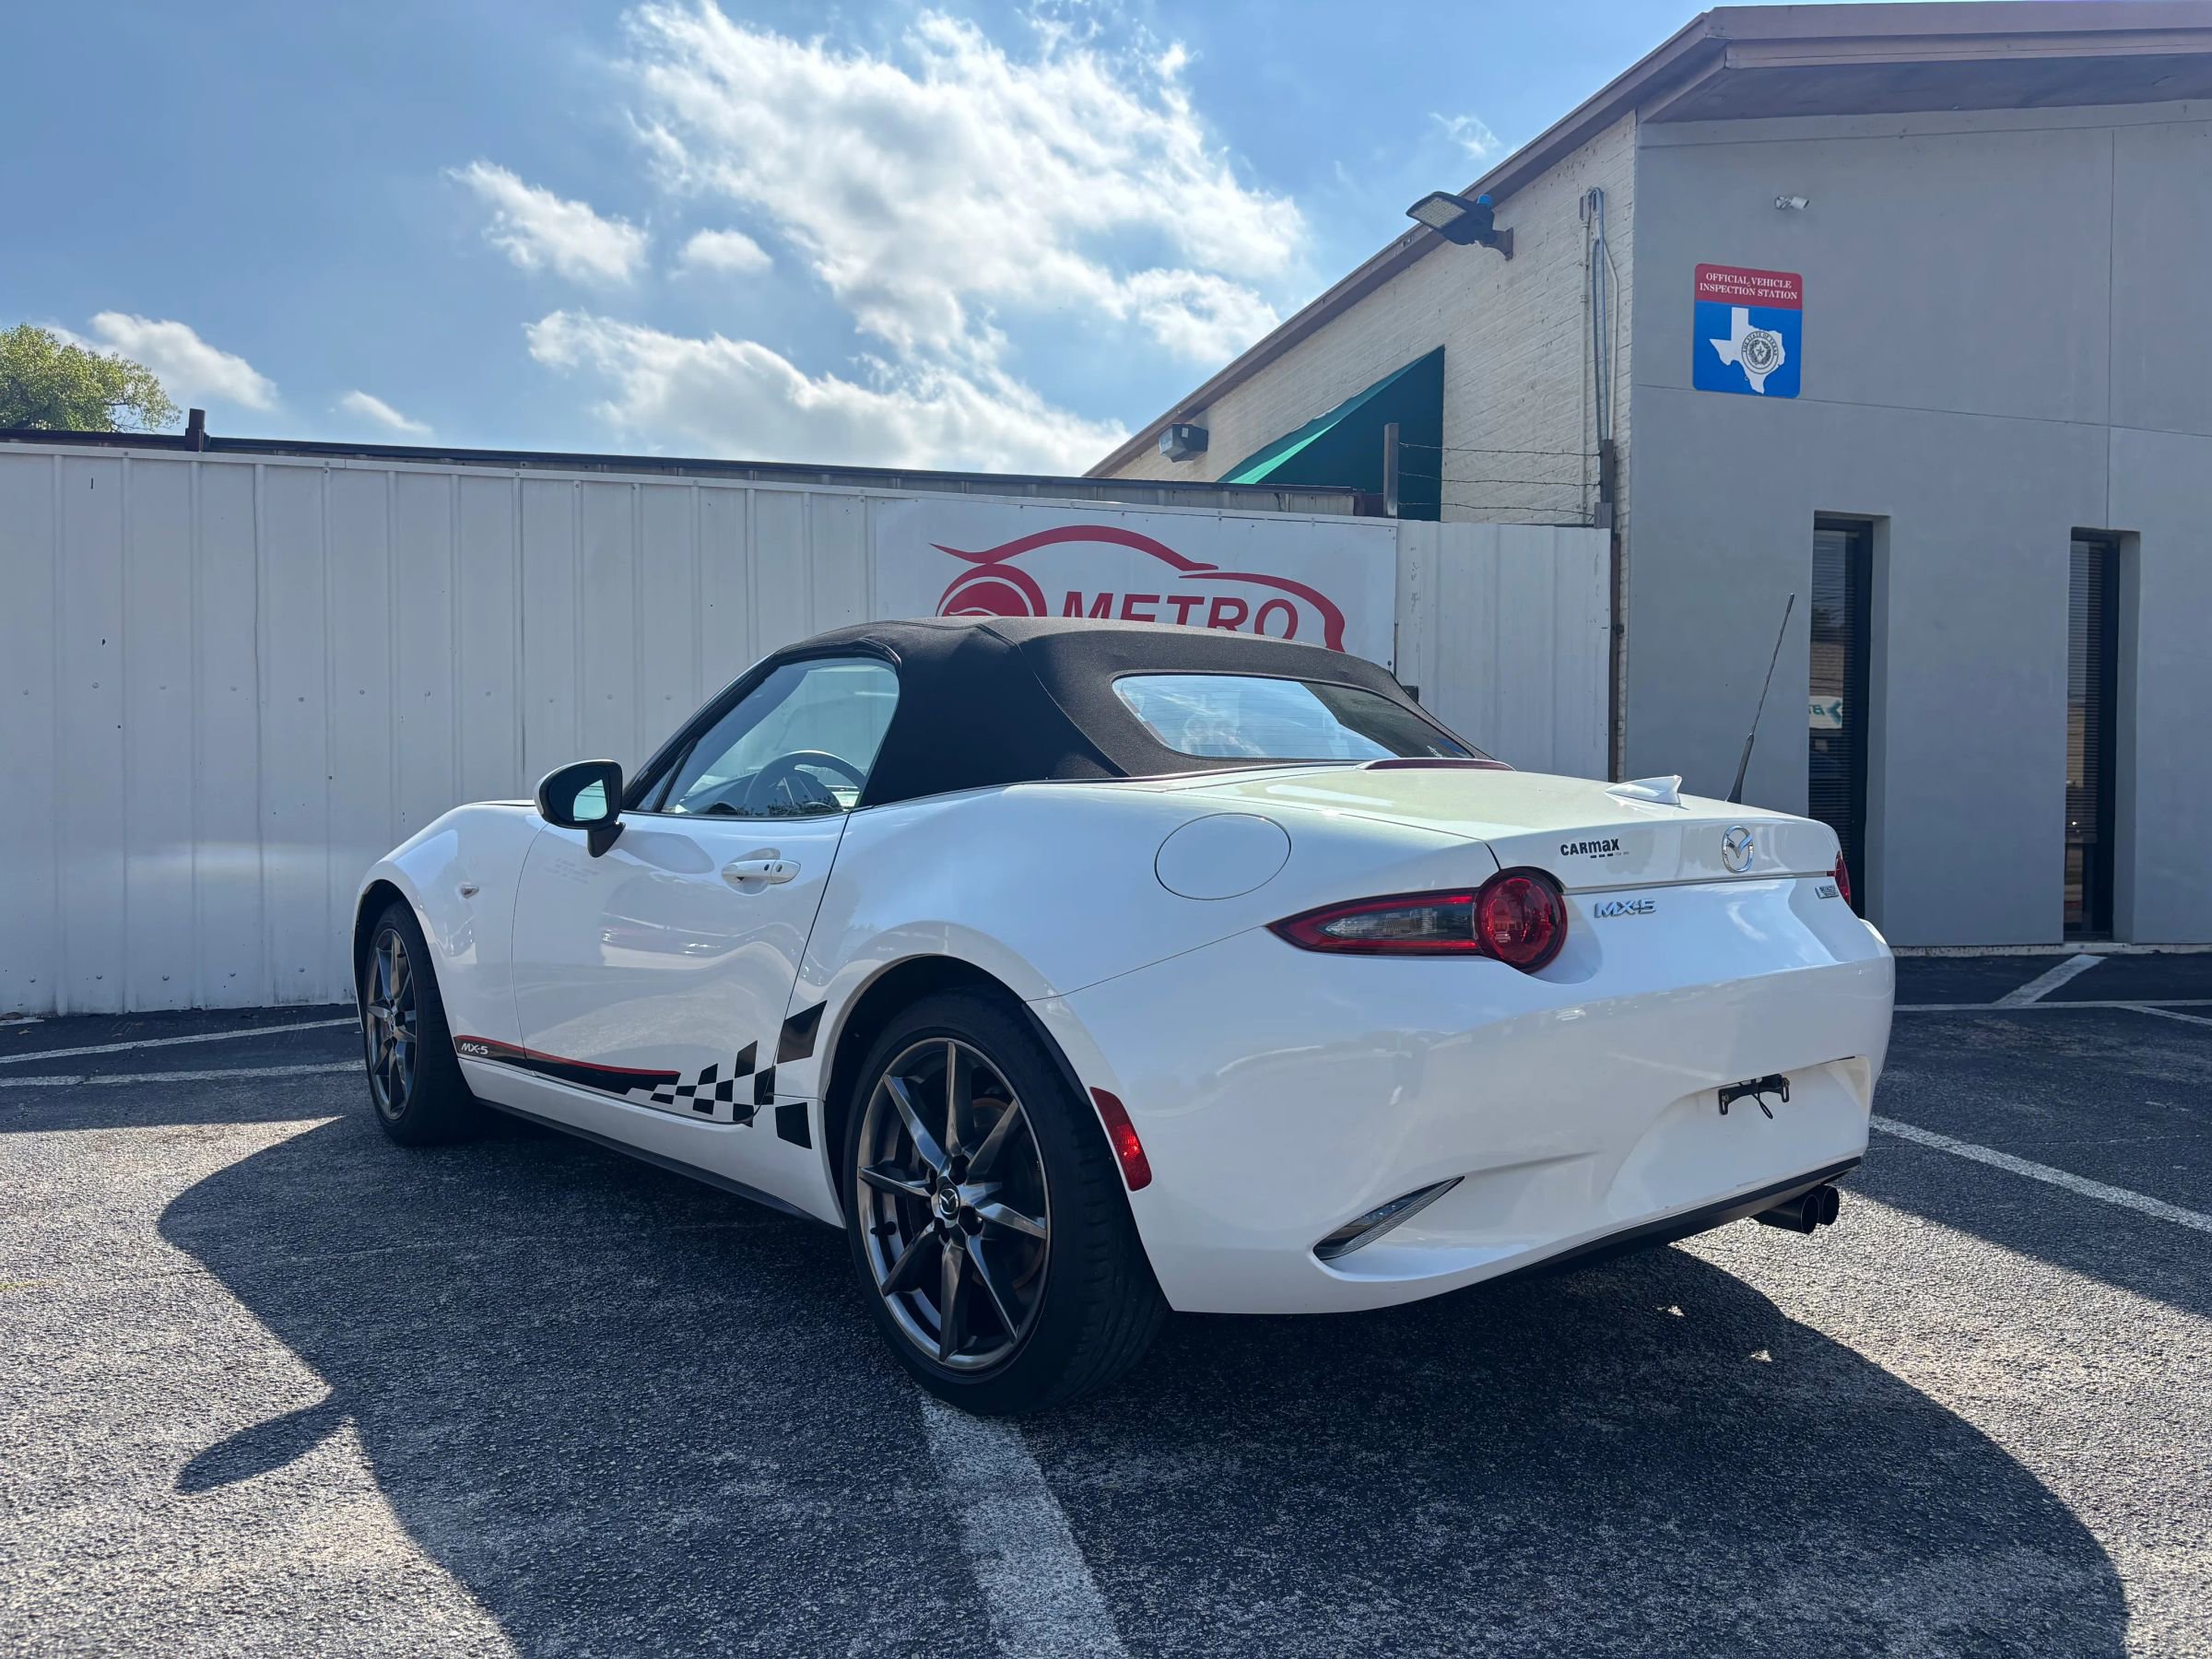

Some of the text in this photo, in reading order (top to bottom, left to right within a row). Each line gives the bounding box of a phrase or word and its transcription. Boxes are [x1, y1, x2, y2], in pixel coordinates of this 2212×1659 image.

[1706, 272, 1792, 288] OFFICIAL VEHICLE
[1699, 282, 1797, 300] INSPECTION STATION
[1063, 591, 1299, 641] METRO
[1594, 899, 1657, 919] MX-5
[461, 1042, 488, 1055] MX-5
